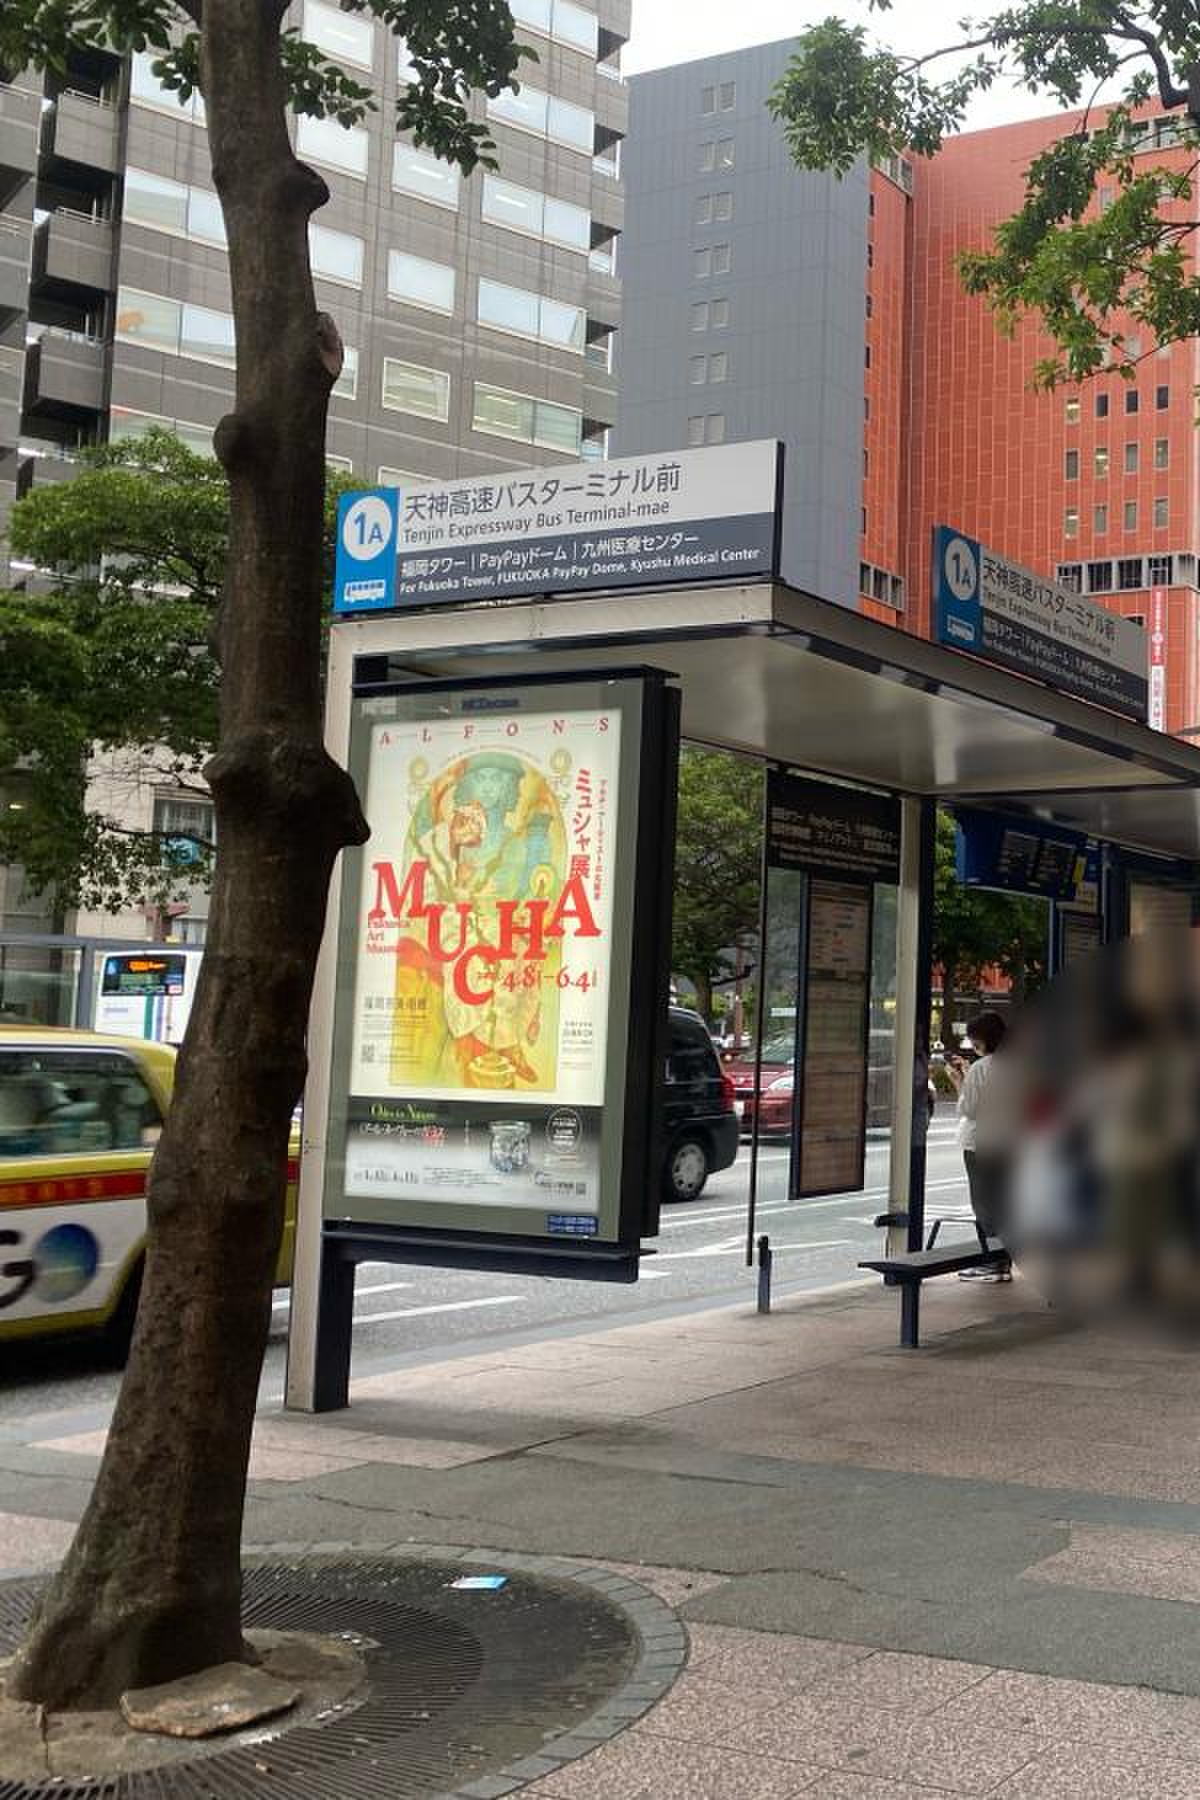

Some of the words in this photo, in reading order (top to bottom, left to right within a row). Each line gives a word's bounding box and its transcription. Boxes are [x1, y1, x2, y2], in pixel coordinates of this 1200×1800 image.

[404, 463, 682, 522] 天神高速バスターミナル前
[353, 512, 384, 545] 1A
[404, 526, 444, 545] Tenjin
[449, 518, 533, 539] Expressway
[536, 512, 562, 528] Bus
[567, 501, 670, 523] Terminal-mae
[720, 548, 761, 562] Center
[951, 552, 971, 586] 1A
[574, 768, 592, 880] ミュシャ展
[366, 860, 602, 1006] MUCHA
